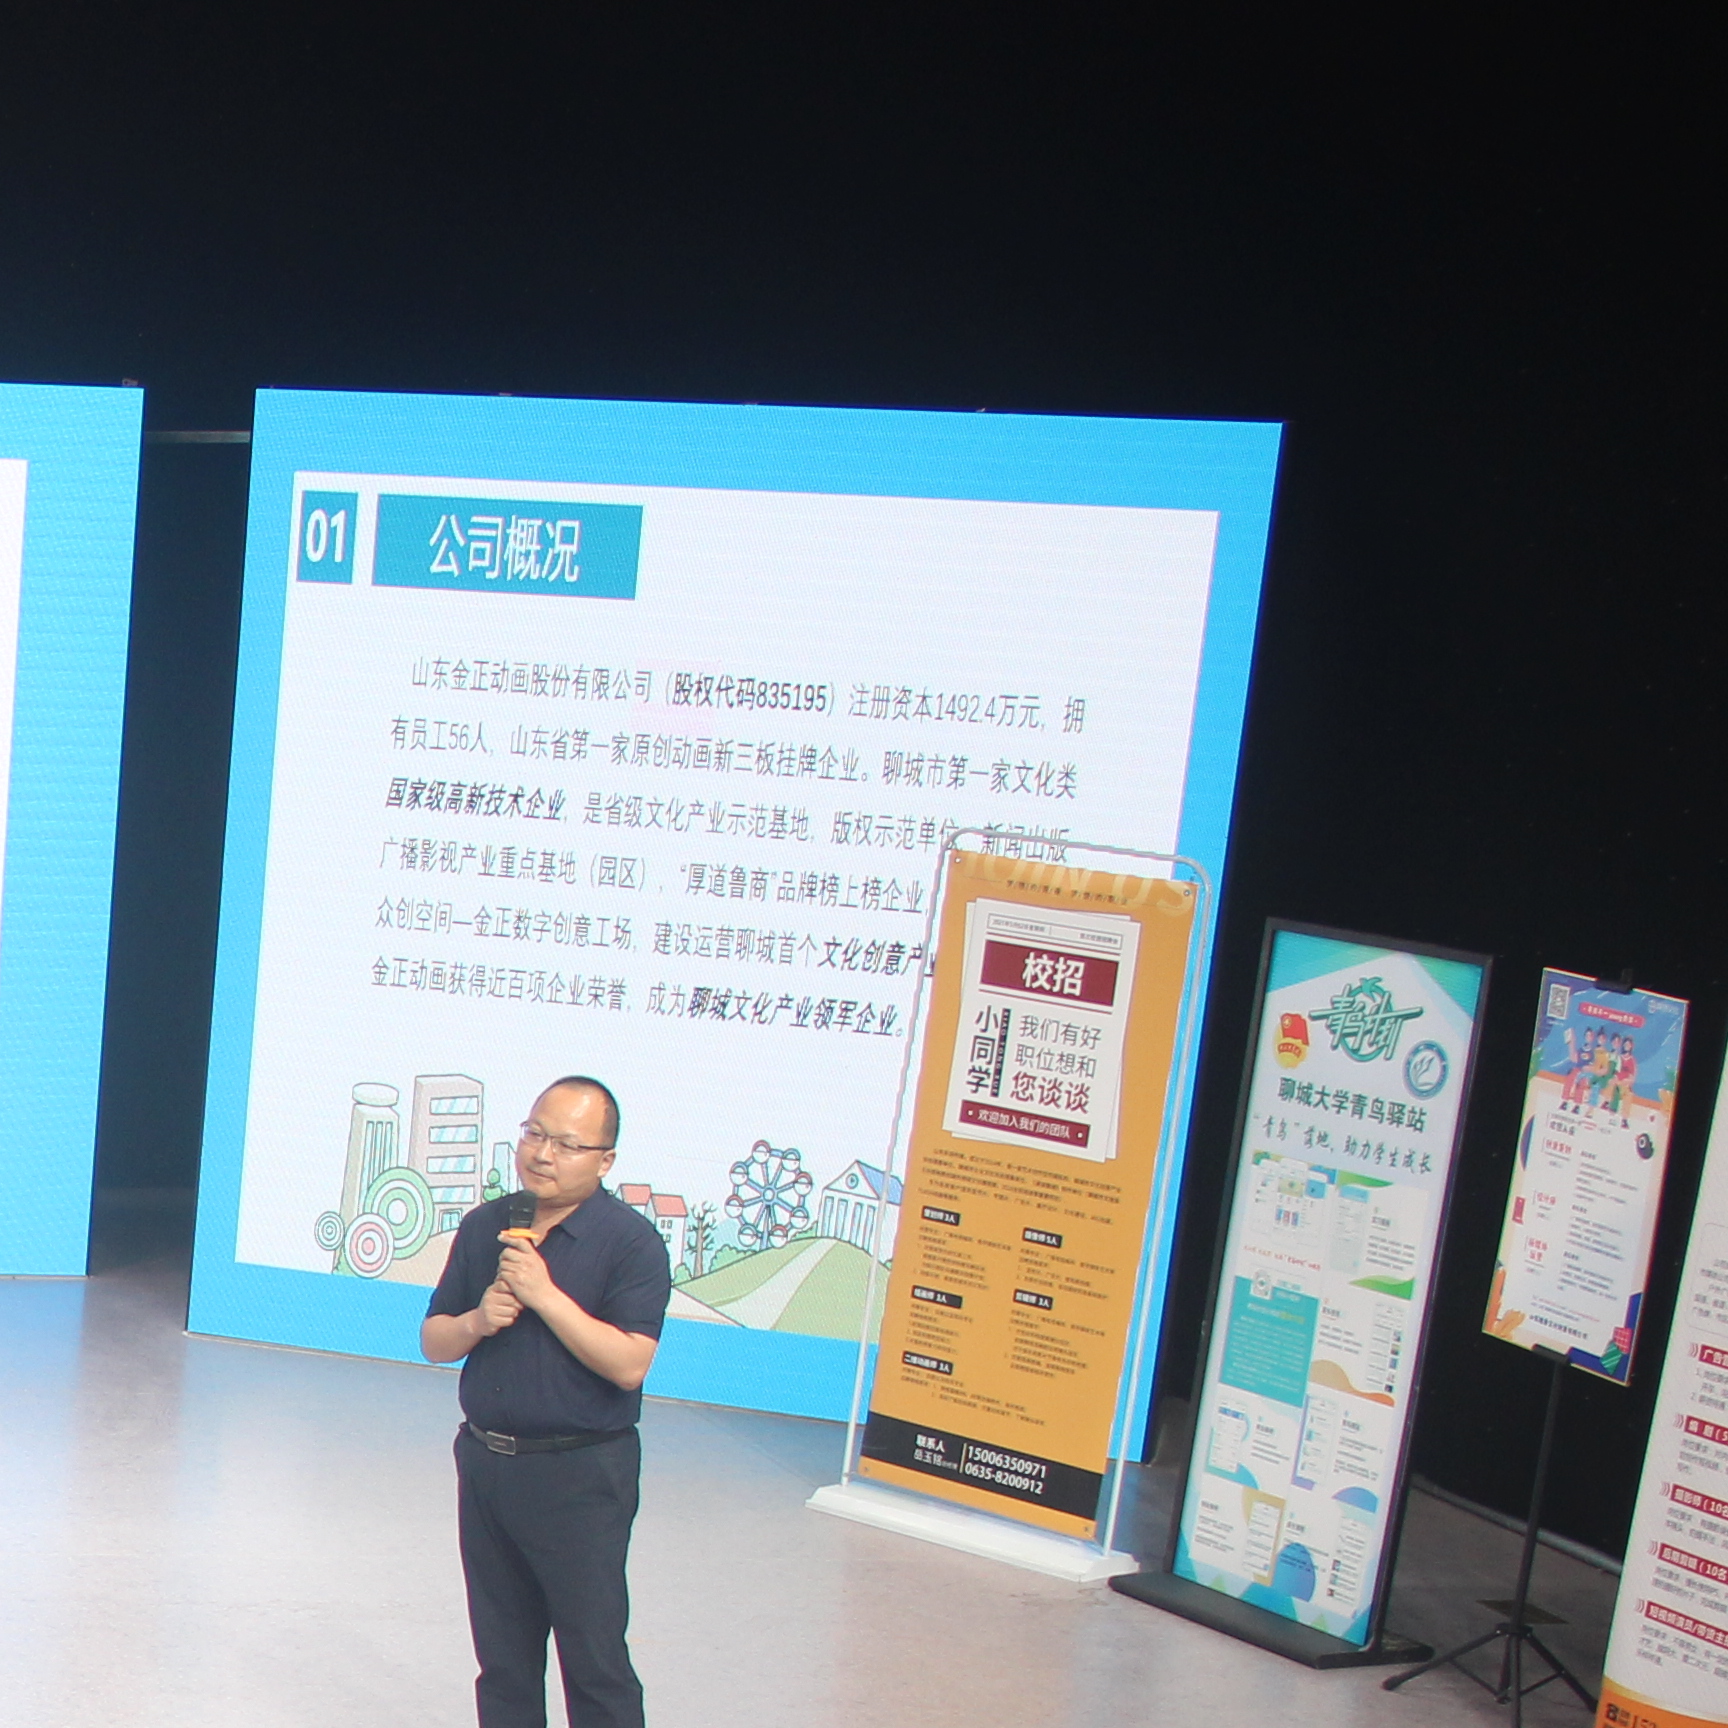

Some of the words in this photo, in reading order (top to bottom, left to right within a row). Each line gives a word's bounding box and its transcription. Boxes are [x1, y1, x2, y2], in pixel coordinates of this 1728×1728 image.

[305, 509, 346, 563] 01
[427, 512, 582, 584] 公司概况
[1021, 952, 1086, 998] 校招
[965, 1004, 1000, 1095] 小同学
[1019, 1014, 1102, 1051] 我们有好
[1014, 1043, 1098, 1080] 职位想和
[1009, 1070, 1092, 1115] 您谈谈
[1277, 1076, 1428, 1134] 聊城大学青鸟驿站
[977, 1108, 1071, 1139] 欢迎加入我们的团队
[915, 1433, 945, 1453] 联系人
[967, 1445, 1047, 1479] 15006350971
[964, 1462, 1044, 1495] 0635-8200912
